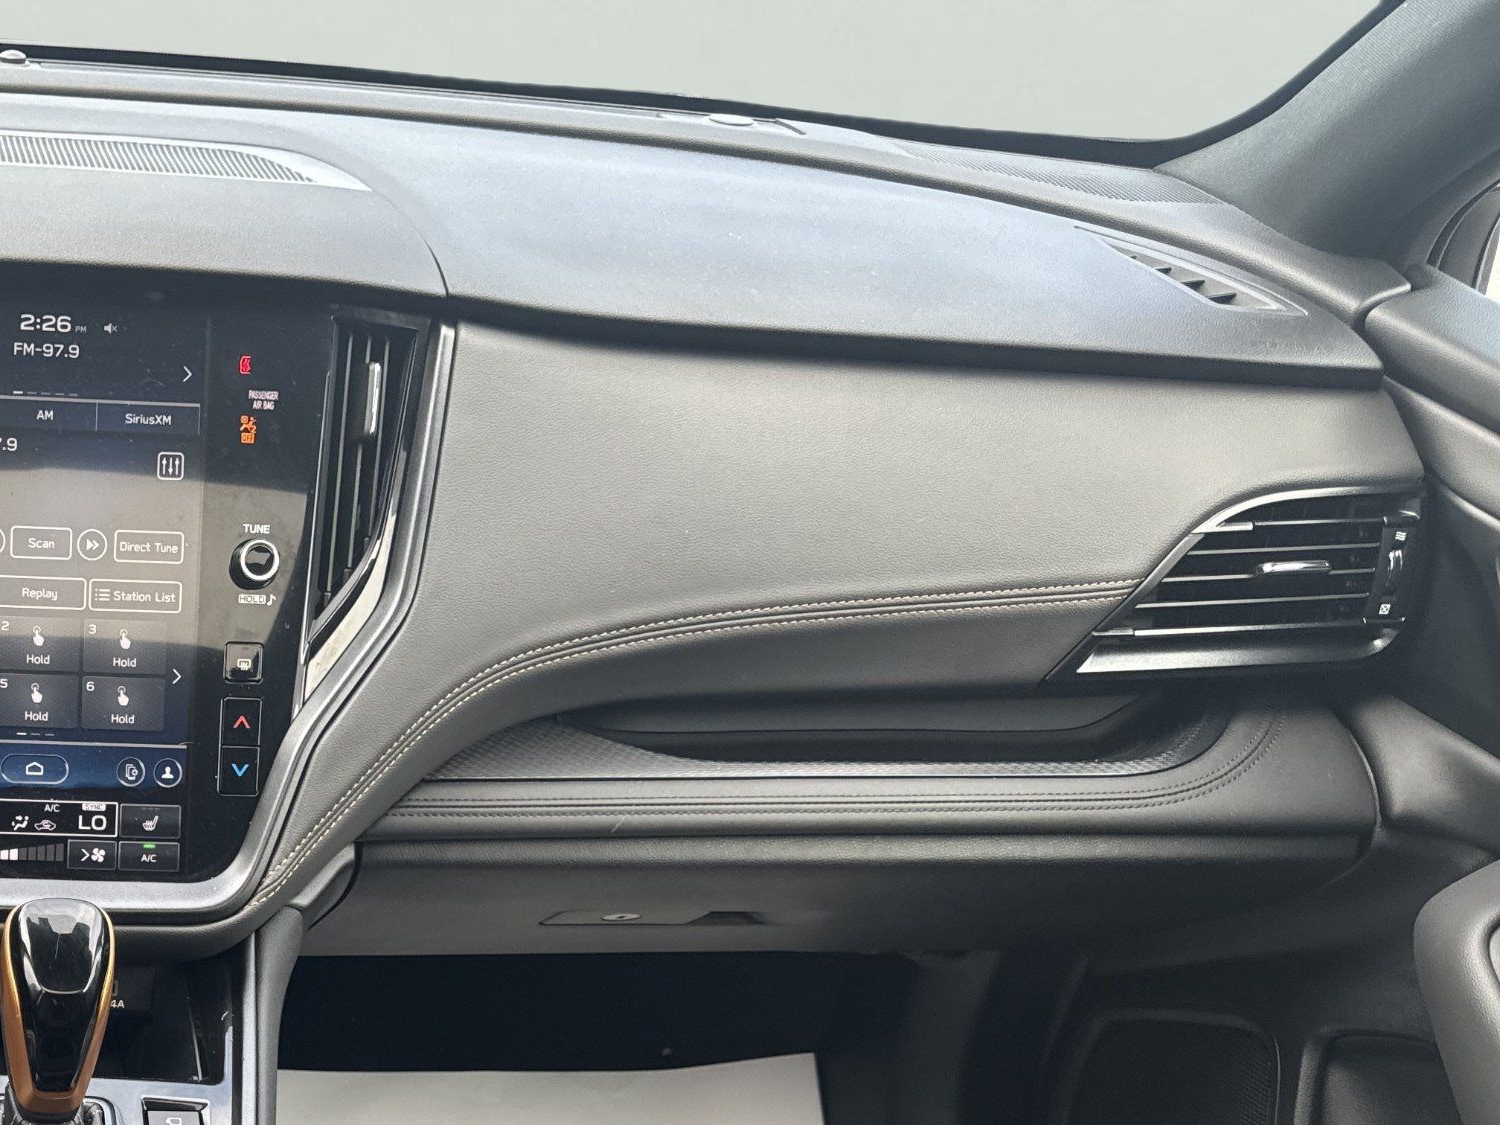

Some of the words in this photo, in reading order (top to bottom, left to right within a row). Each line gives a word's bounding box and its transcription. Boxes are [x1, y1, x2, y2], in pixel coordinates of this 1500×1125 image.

[20, 314, 72, 332] 2:26
[13, 342, 80, 358] FM-97.9
[36, 410, 53, 420] AM
[125, 414, 172, 426] SiriusXM
[243, 523, 271, 534] TUNE
[28, 537, 55, 549] Scan
[119, 541, 151, 552] Direct
[155, 543, 179, 554] Tune
[22, 587, 58, 602] Replay
[113, 590, 152, 602] Station
[155, 592, 176, 604] List
[239, 594, 266, 604] HOLD
[1, 621, 10, 631] 2
[88, 624, 97, 634] 3
[26, 654, 50, 665] Hold
[112, 657, 137, 668] Hold
[0, 678, 8, 689] 5
[86, 681, 95, 691] 6
[24, 711, 48, 722] Hold
[111, 714, 135, 724] Hold
[44, 803, 60, 813] A/C
[78, 814, 107, 831] LO
[140, 853, 157, 863] A/C
